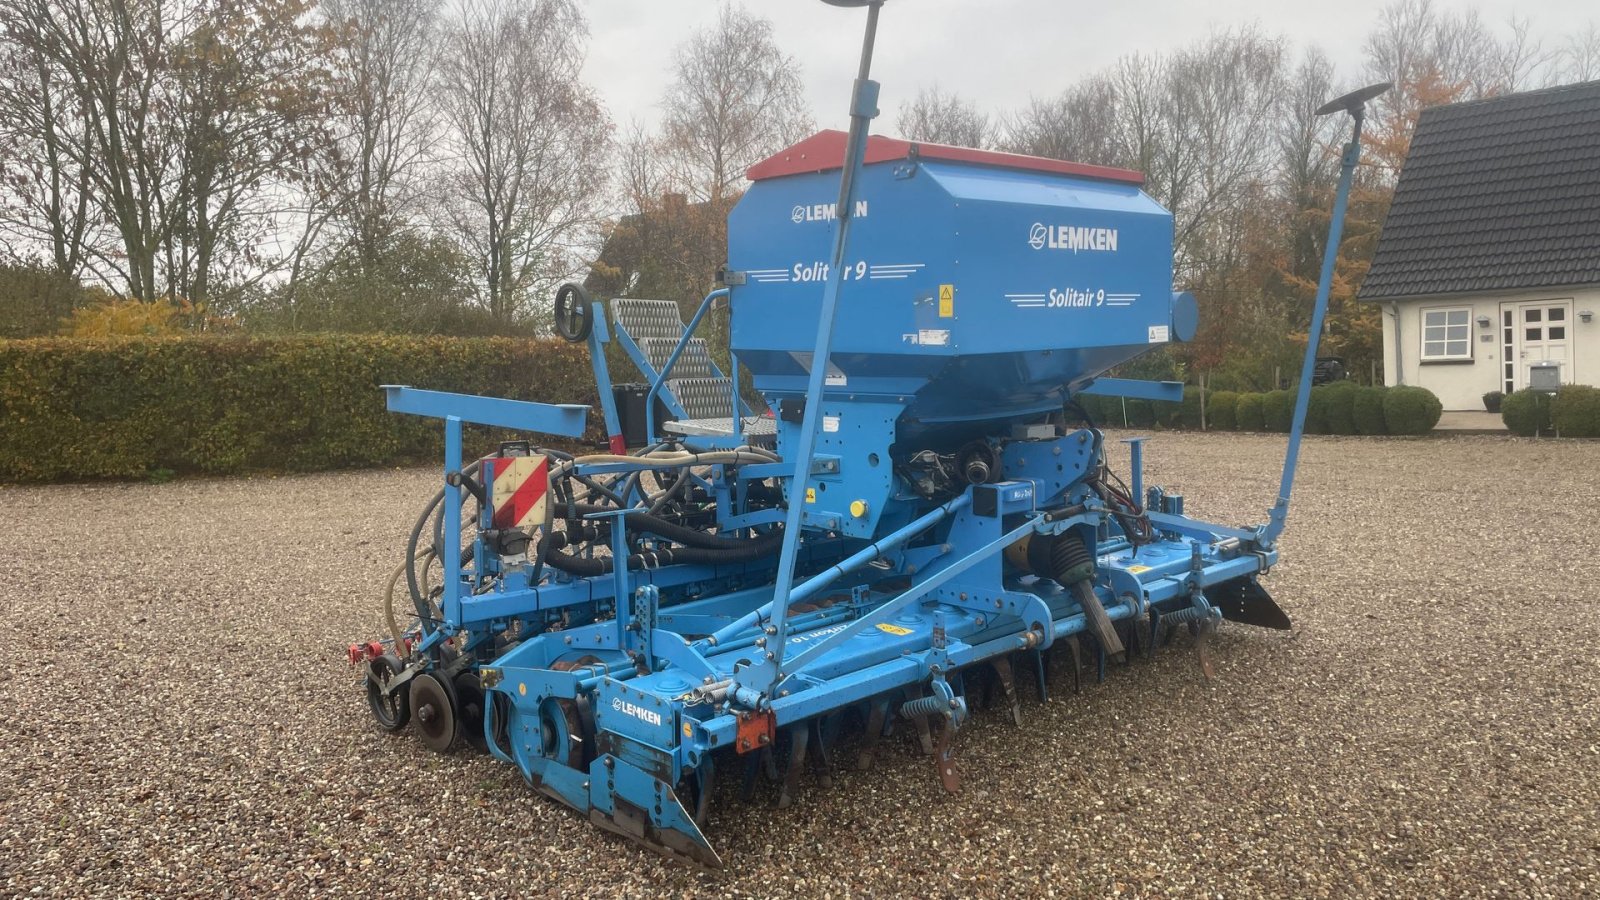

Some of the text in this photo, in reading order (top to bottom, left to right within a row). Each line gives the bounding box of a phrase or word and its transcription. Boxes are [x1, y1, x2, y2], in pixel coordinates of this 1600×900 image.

[806, 201, 868, 222] LEMN
[1048, 225, 1118, 255] LEMKEN
[792, 261, 867, 282] Solitr 9
[1048, 288, 1105, 307] Solitair 9
[622, 701, 661, 726] LEMKEN
